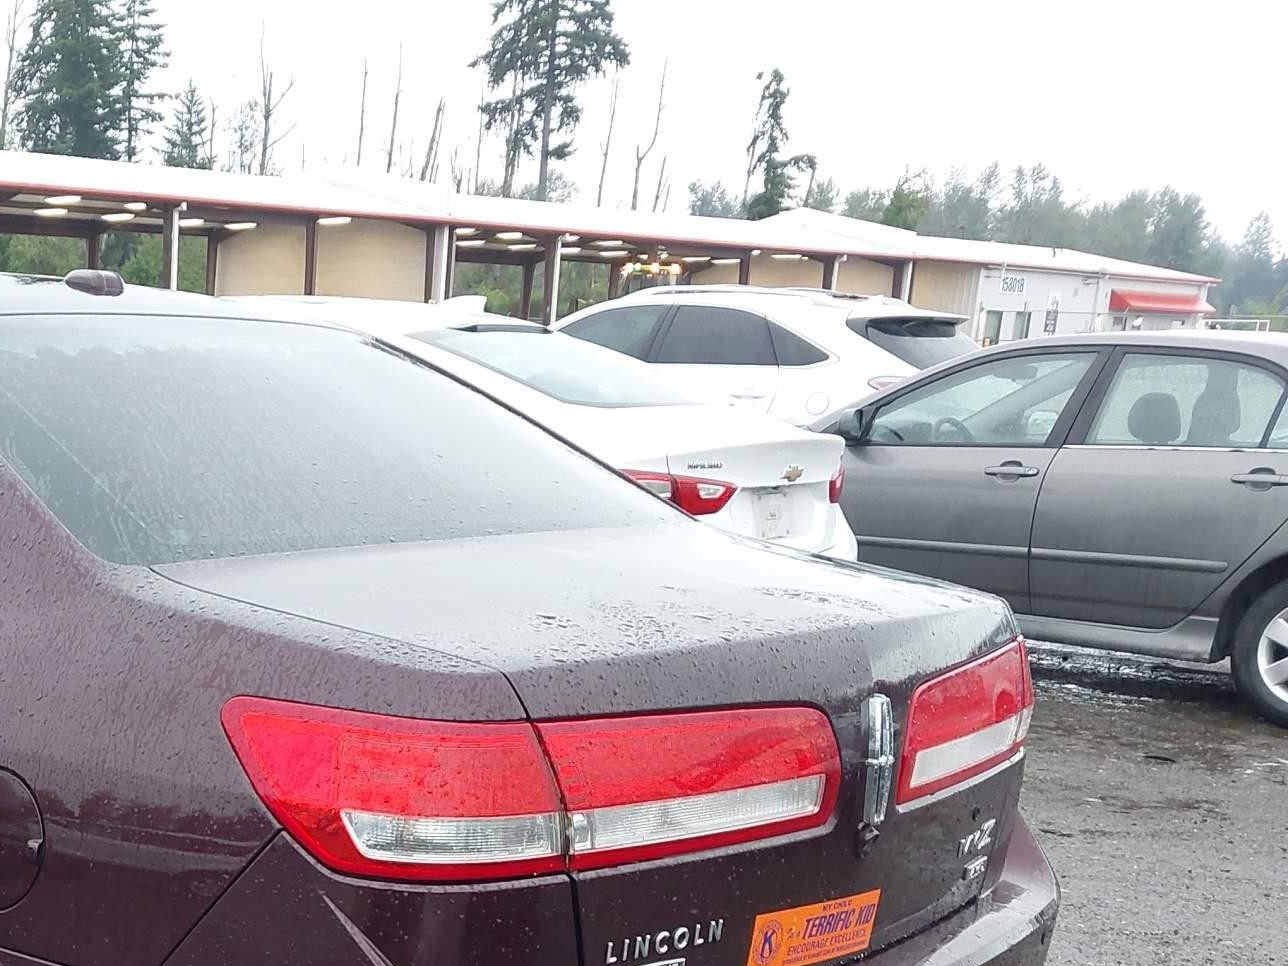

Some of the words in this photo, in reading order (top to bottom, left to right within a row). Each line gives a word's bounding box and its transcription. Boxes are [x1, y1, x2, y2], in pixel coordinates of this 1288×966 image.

[606, 918, 724, 964] LINCOLN
[802, 908, 857, 940] TERRIFIC
[855, 903, 876, 926] KID
